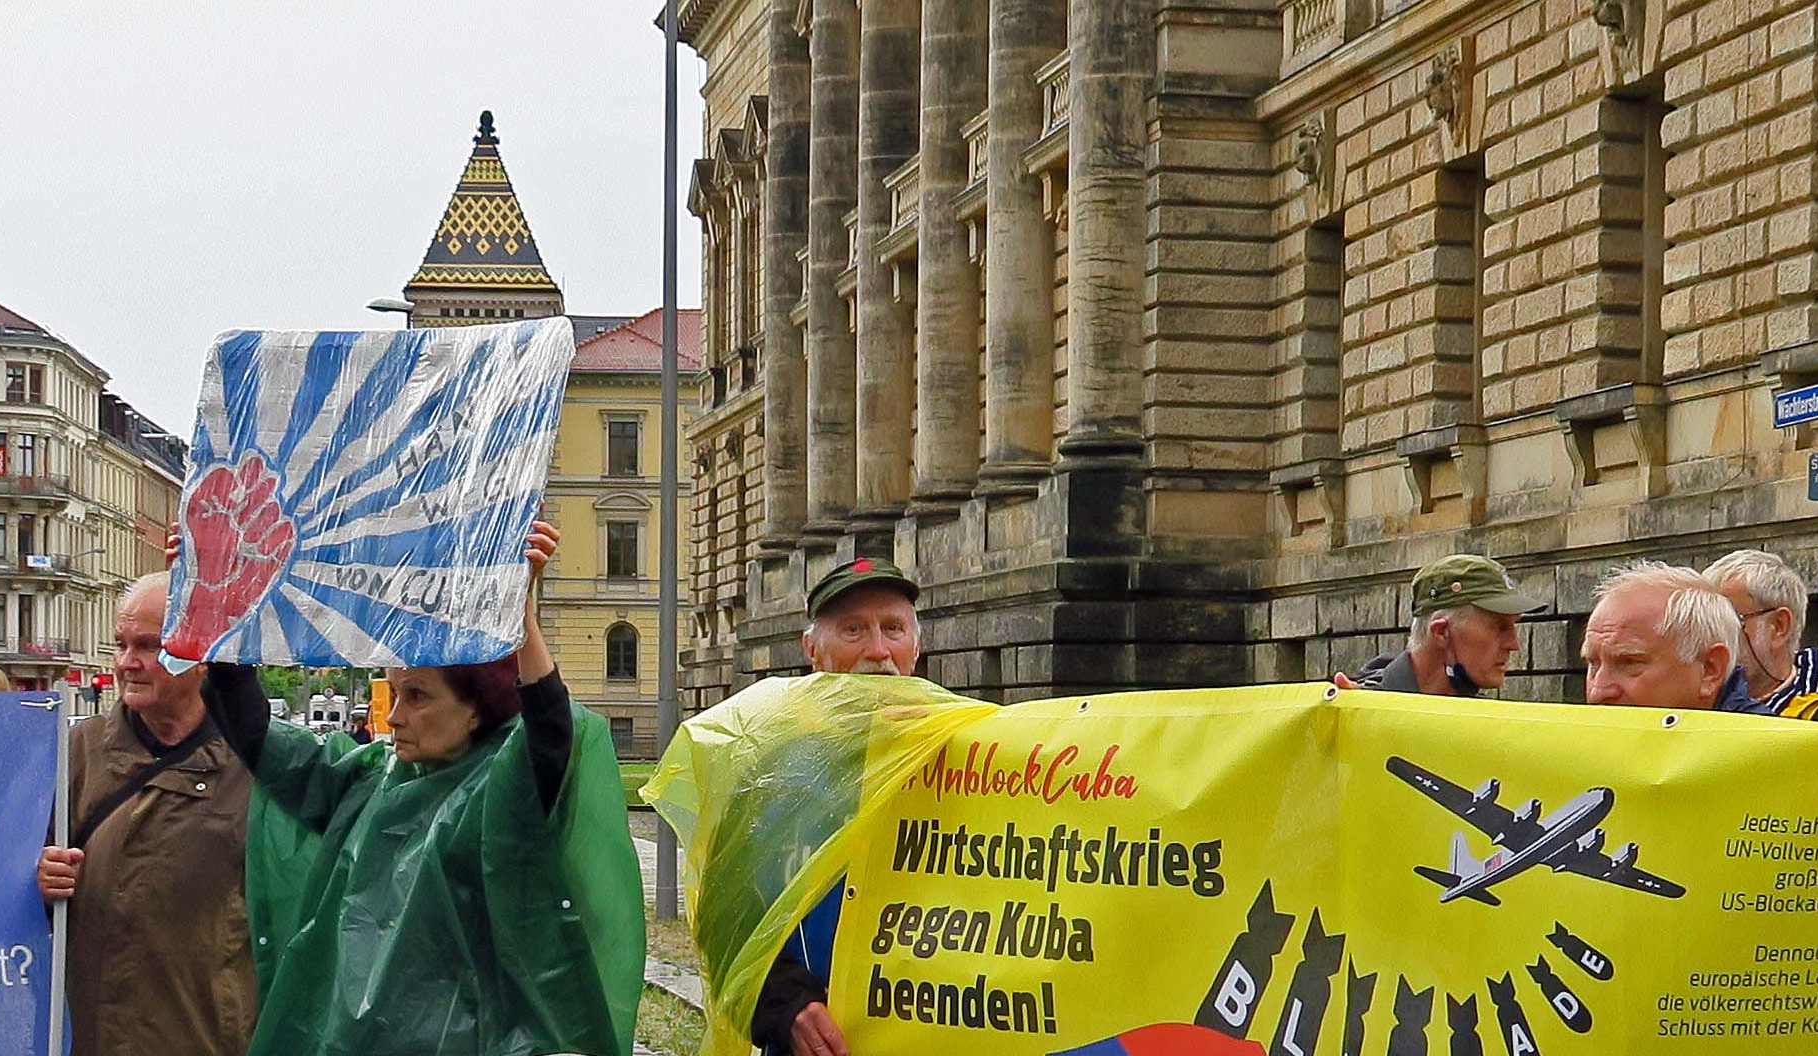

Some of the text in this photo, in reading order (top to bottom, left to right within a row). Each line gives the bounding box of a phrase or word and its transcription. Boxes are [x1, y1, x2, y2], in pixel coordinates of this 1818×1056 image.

[900, 741, 1140, 804] UnblockCuba
[1740, 813, 1789, 834] Jedes
[892, 818, 1225, 897] Wirtschaftskrieg
[871, 901, 1095, 963] gegen Kuba
[866, 963, 1057, 1034] beenden!
[1689, 968, 1800, 990] europäische
[1657, 993, 1684, 1011] die
[1657, 1018, 1725, 1037] Schluss
[1731, 1018, 1761, 1036] mit
[1766, 1018, 1796, 1036] der
